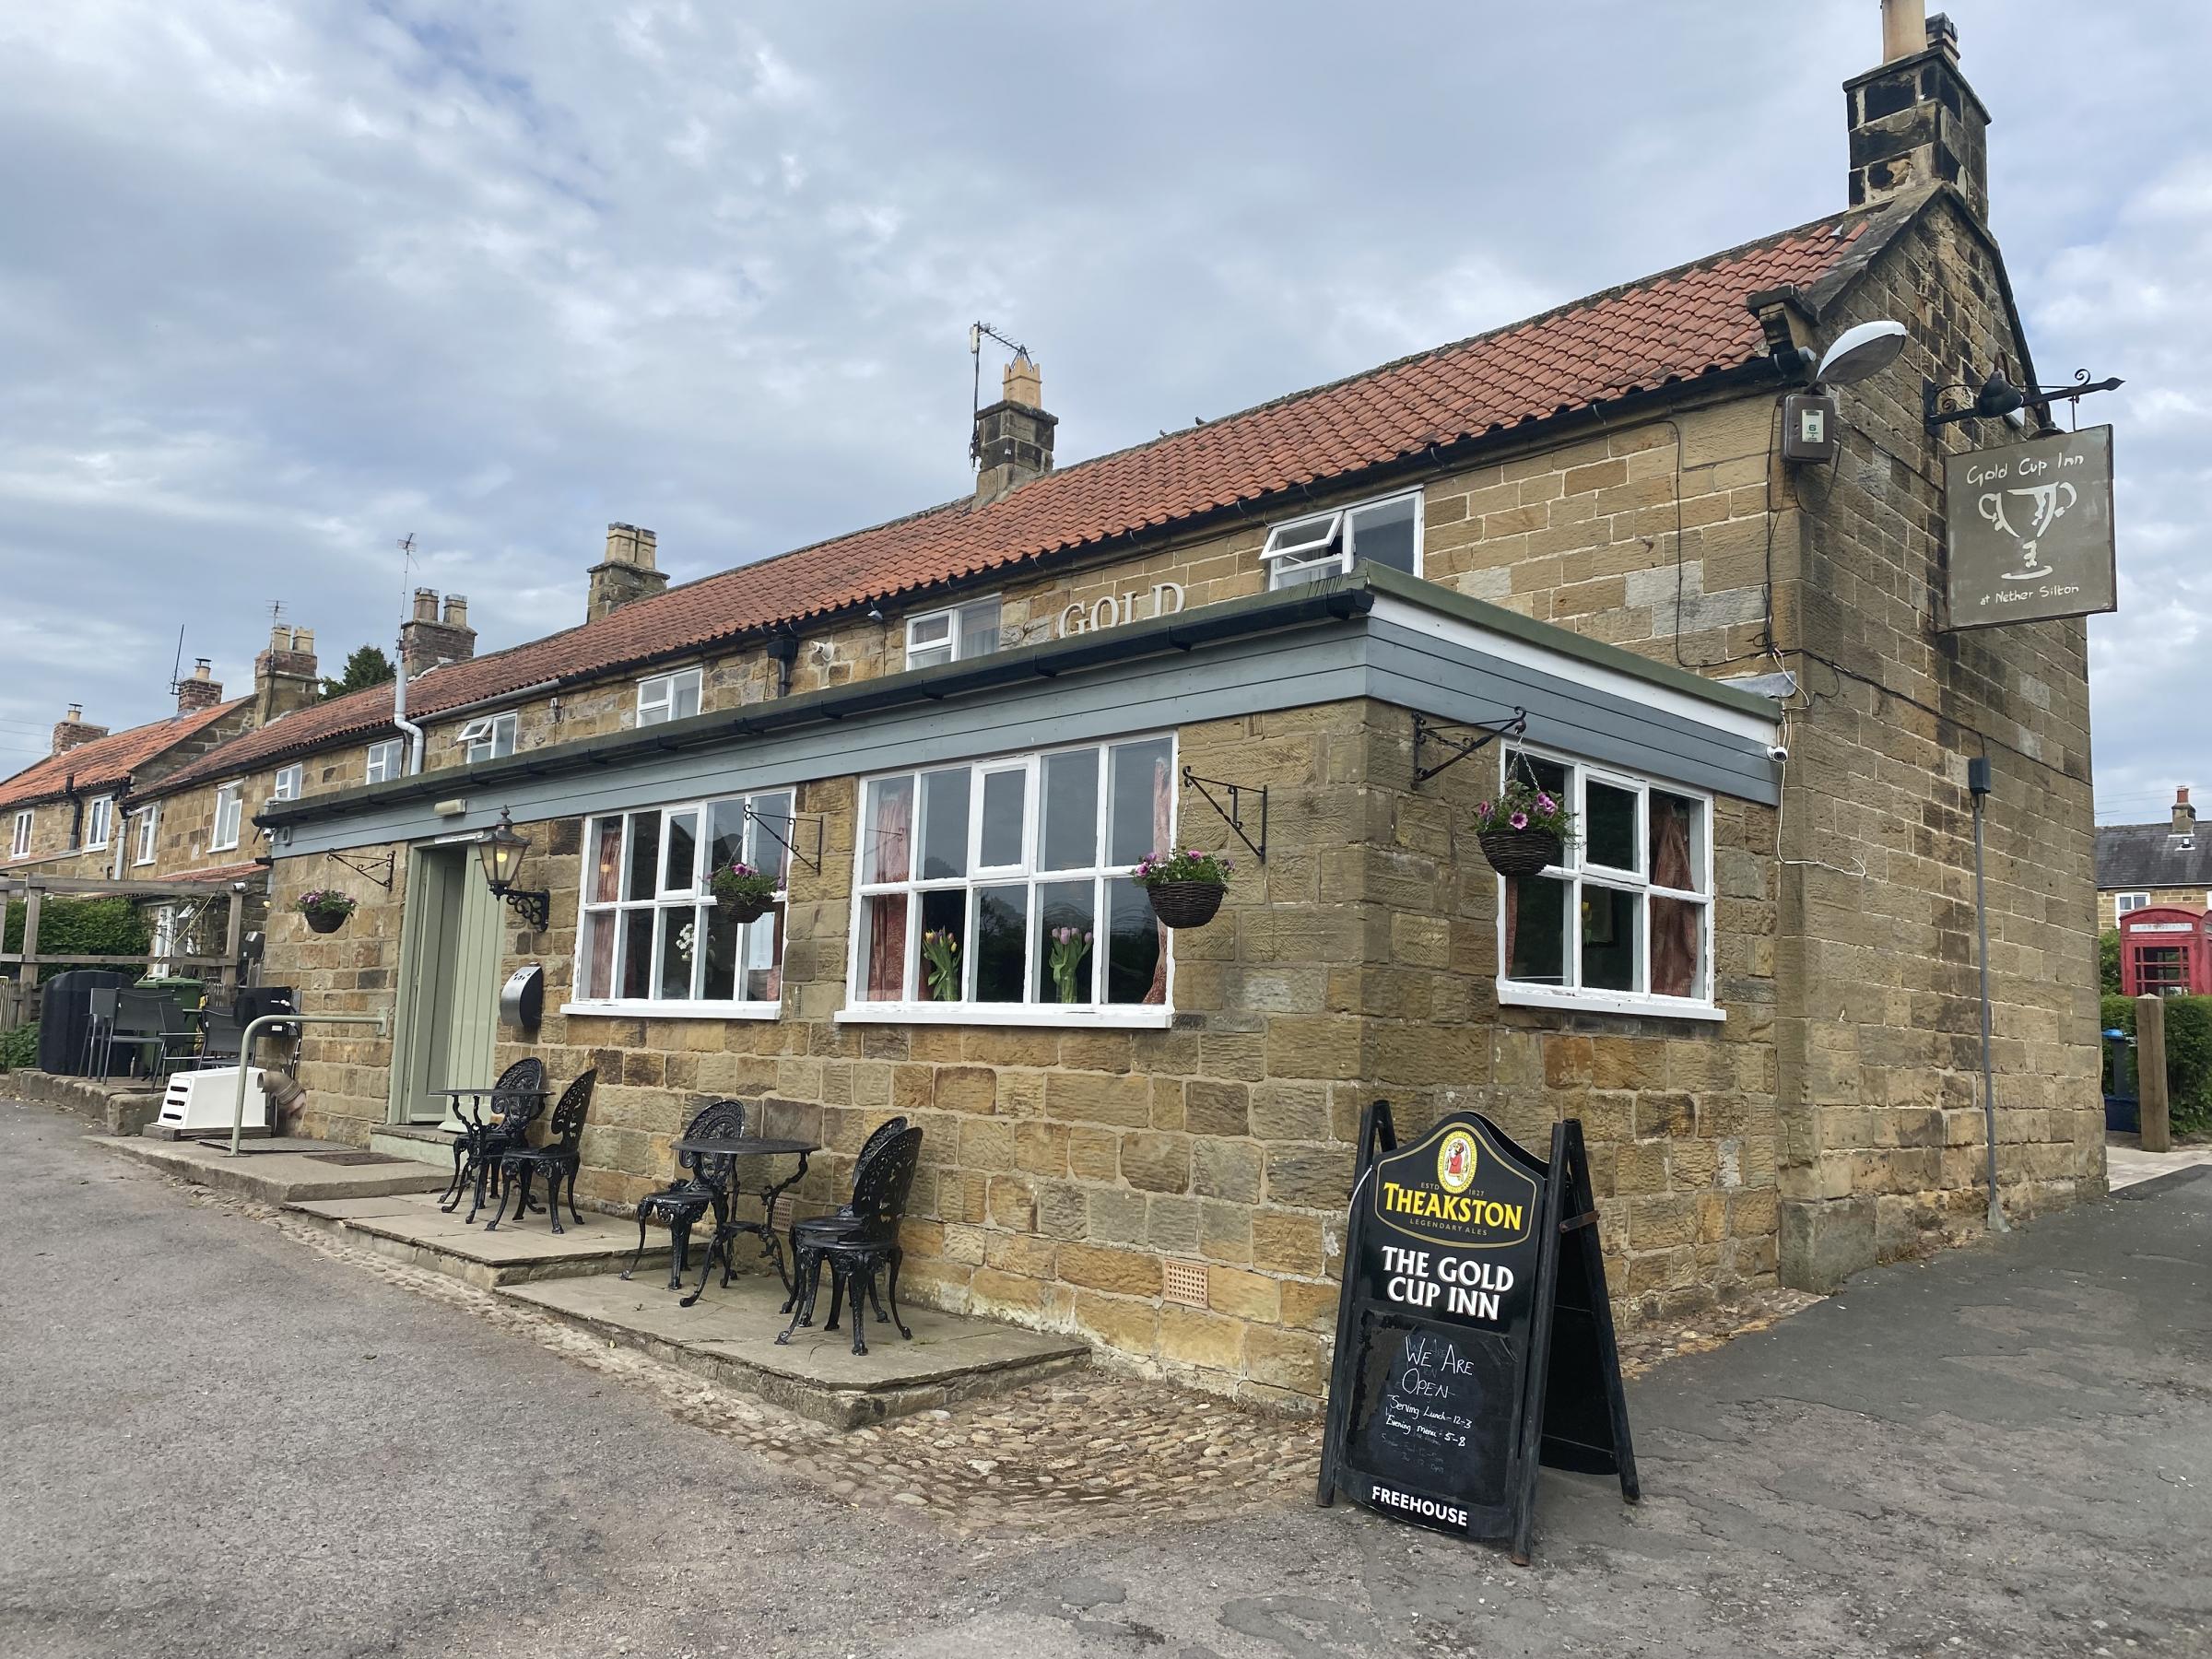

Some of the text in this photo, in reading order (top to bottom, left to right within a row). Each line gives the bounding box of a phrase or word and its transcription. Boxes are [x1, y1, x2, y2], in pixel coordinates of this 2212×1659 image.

[1967, 452, 2084, 487] Gold Cup Inn
[1058, 582, 1186, 639] GOLD
[1981, 585, 2079, 606] at Nether Silton
[1420, 1182, 1440, 1191] ESTD
[1383, 1182, 1524, 1230] THEAKSTON
[1409, 1218, 1488, 1236] LEGENDARY ALES
[1382, 1245, 1514, 1293] THE GOLD
[1386, 1276, 1500, 1321] CUP INN
[1388, 1394, 1420, 1420] Serving
[1386, 1414, 1412, 1435] Evening
[1444, 1431, 1466, 1447] 5-8
[1371, 1485, 1468, 1527] FREEHOUSE
